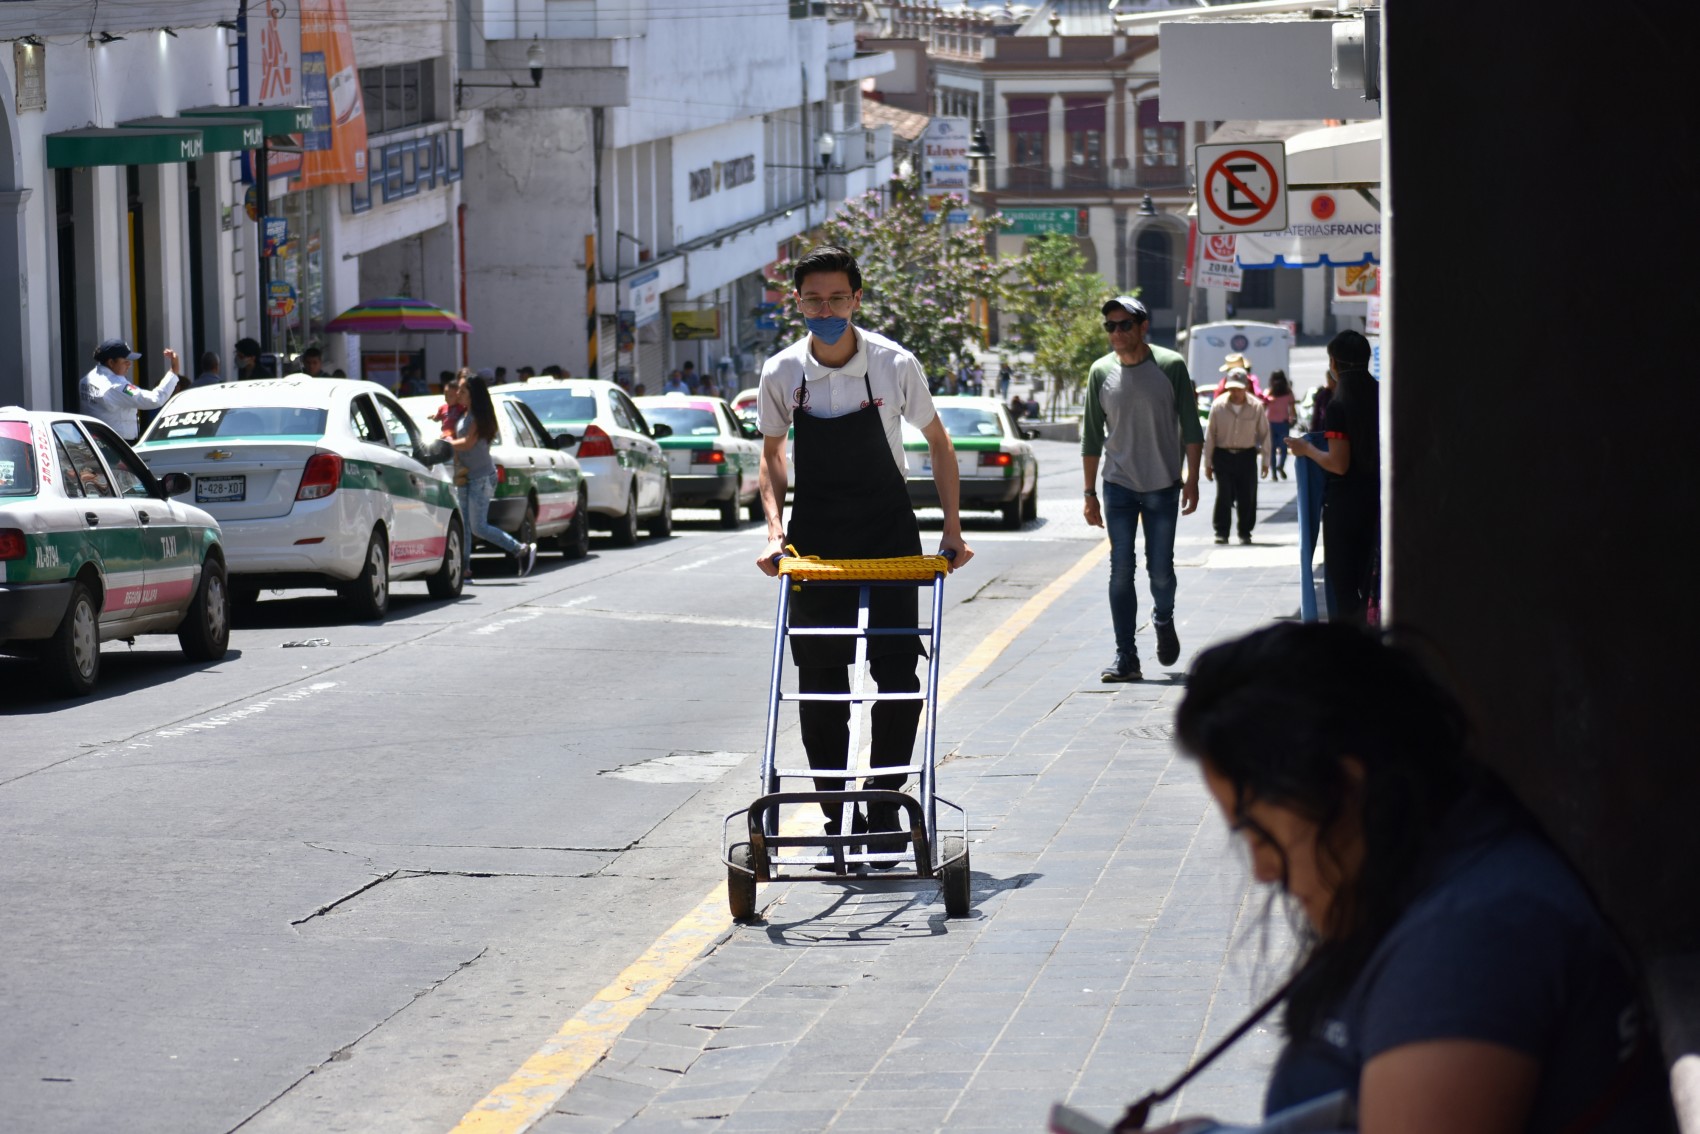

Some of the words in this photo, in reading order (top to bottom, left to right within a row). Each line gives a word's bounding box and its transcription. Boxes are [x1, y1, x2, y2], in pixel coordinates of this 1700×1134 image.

[926, 144, 966, 159] Llave
[1226, 164, 1260, 211] E
[1208, 262, 1235, 273] ZONA
[159, 410, 221, 429] XL-8374
[198, 482, 244, 494] A-428-XDT
[161, 536, 177, 559] TAXI
